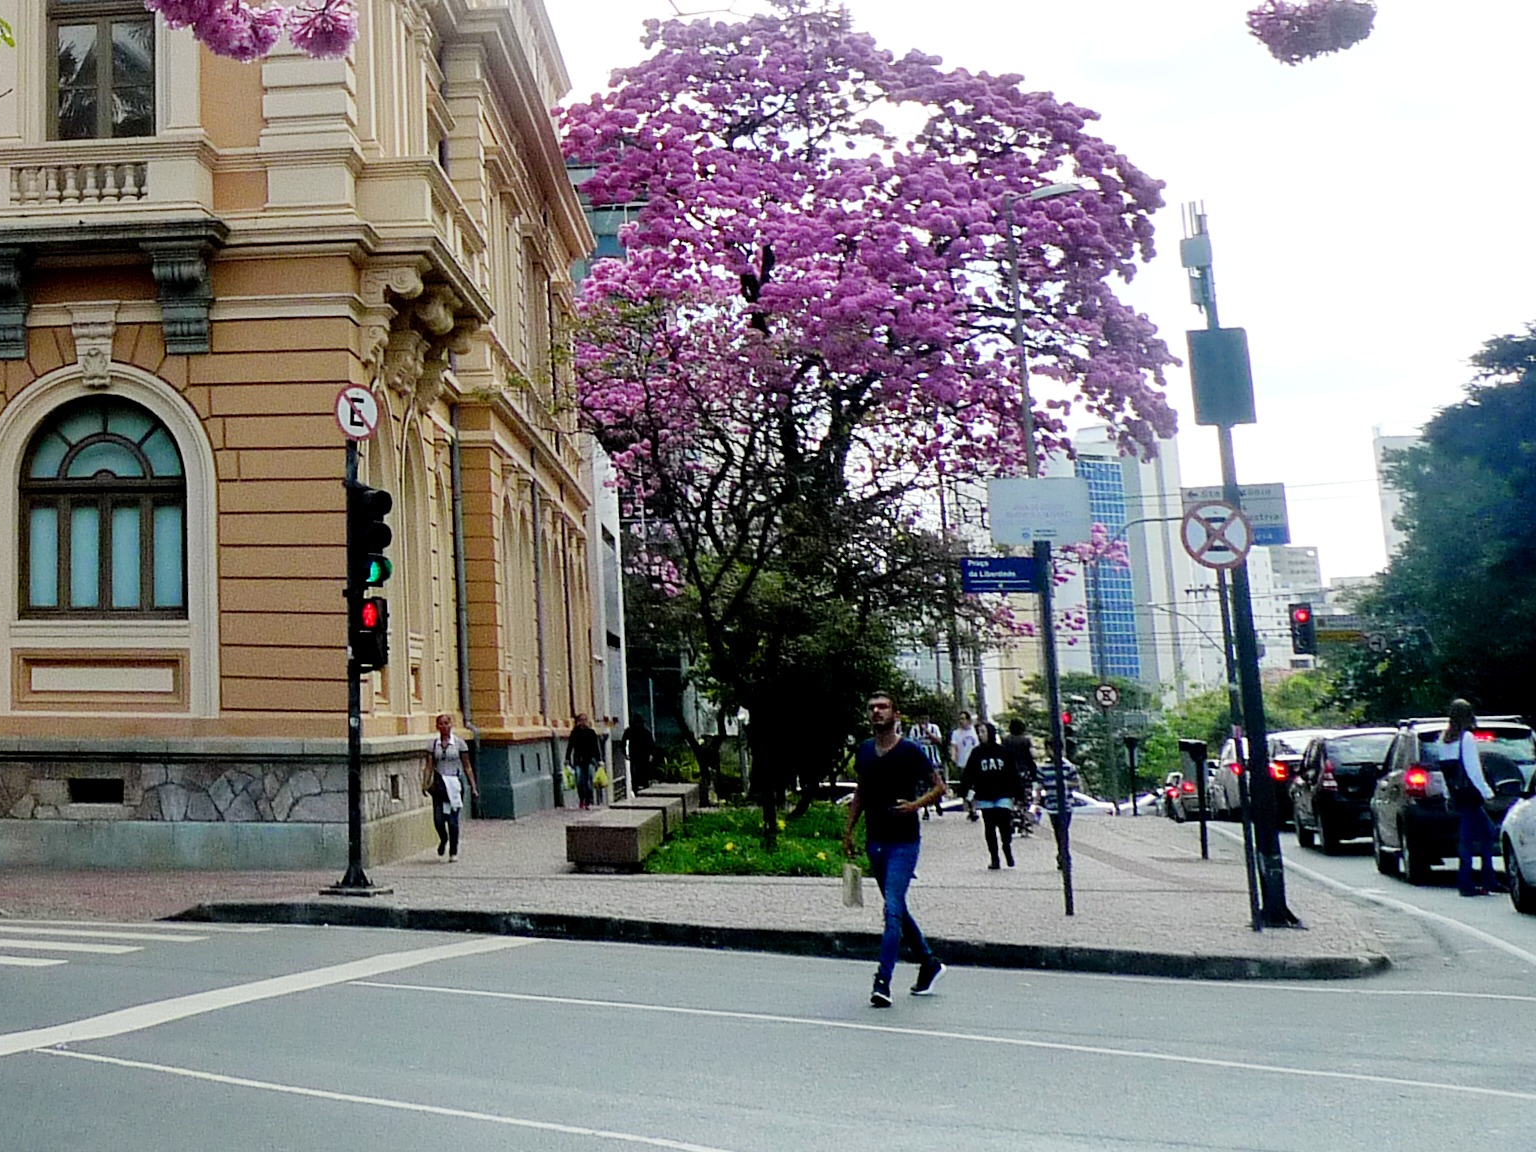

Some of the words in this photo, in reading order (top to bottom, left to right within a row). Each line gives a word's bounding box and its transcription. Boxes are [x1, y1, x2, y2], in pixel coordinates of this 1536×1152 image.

[968, 570, 978, 578] da
[979, 570, 1017, 578] Liberdade
[981, 758, 1004, 771] GAP
